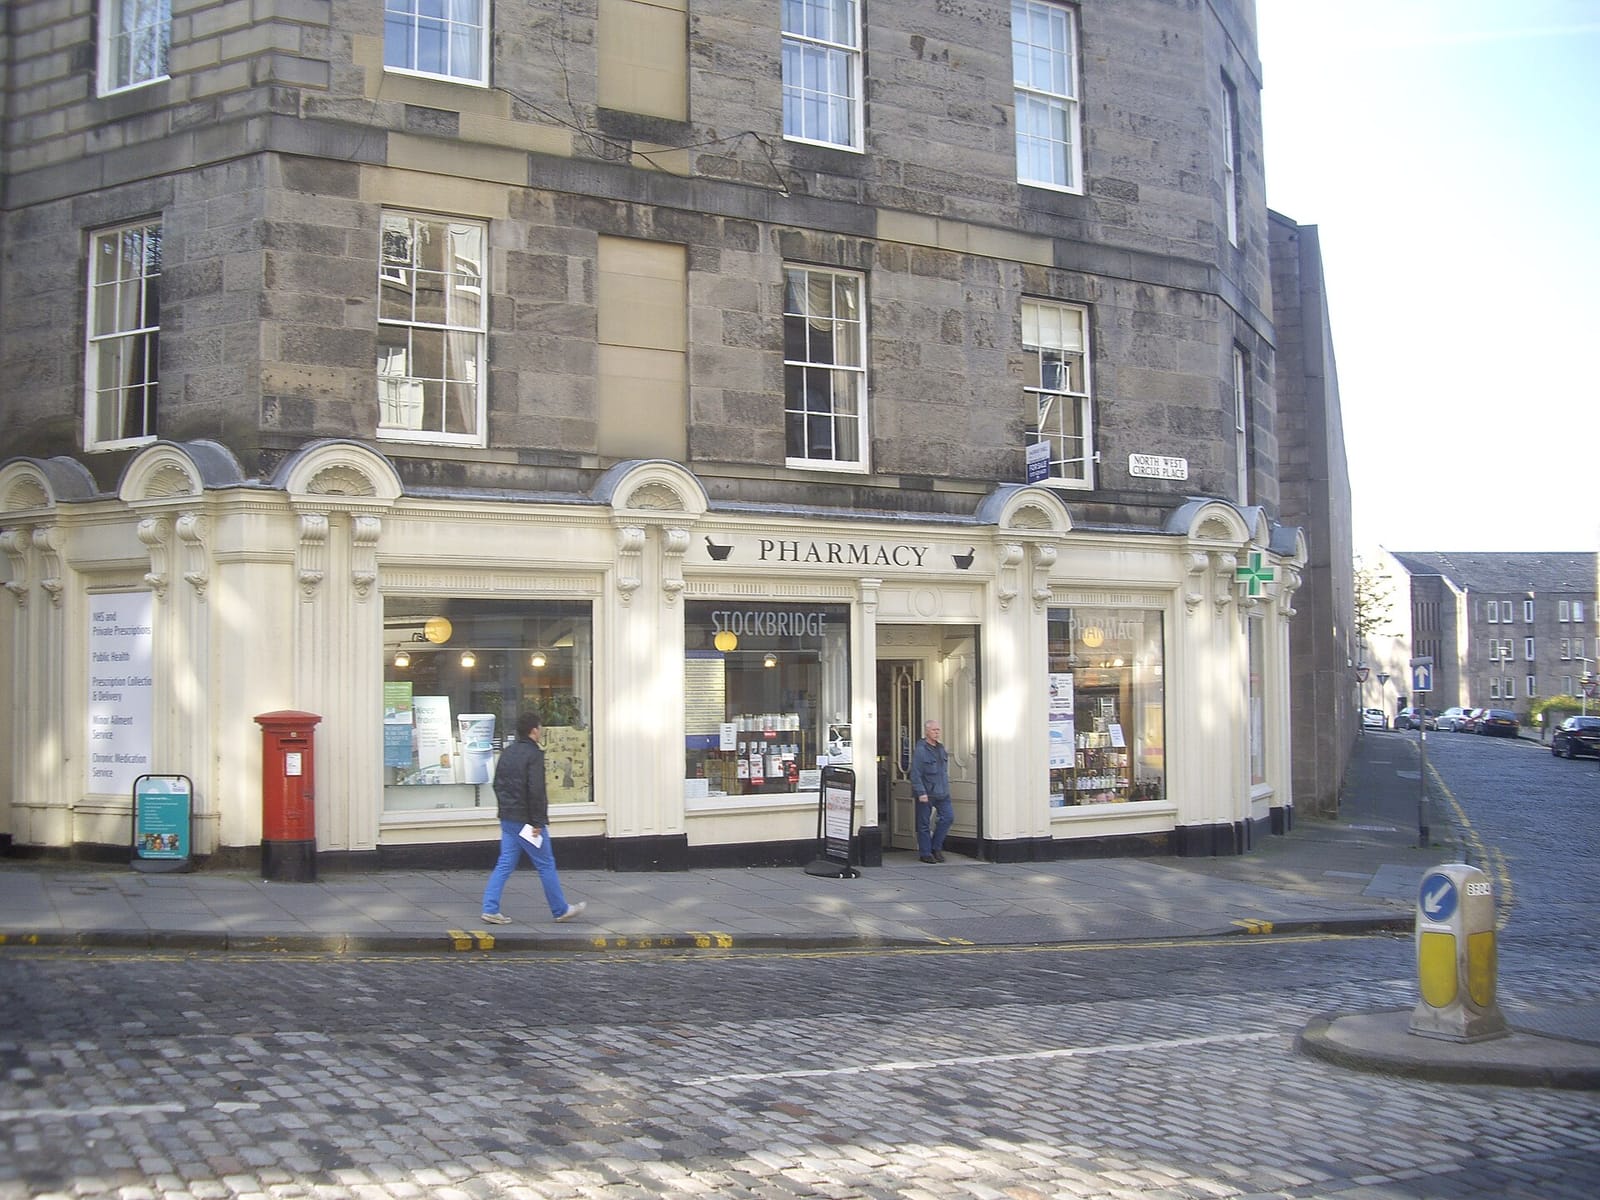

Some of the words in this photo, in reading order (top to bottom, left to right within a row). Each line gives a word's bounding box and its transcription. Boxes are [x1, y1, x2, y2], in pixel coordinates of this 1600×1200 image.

[1133, 455, 1159, 466] NORTH
[1162, 458, 1183, 469] WEST
[1133, 465, 1160, 476] CIRCUS
[1162, 467, 1185, 479] PLACE
[758, 539, 928, 567] PHARMACY
[105, 611, 116, 622] and
[711, 611, 826, 637] STOCKBRIDGE
[1070, 616, 1139, 640] PHARMAC
[92, 626, 113, 637] Private
[114, 625, 152, 637] Prescriptions
[92, 651, 110, 662] Public
[111, 651, 130, 662] Health
[92, 676, 126, 688] Prescription
[127, 675, 152, 687] Collectio
[98, 690, 122, 703] Delivery
[111, 714, 133, 725] Ailment
[92, 729, 113, 740] Service
[92, 752, 113, 763] Chronic
[114, 752, 147, 764] Medication
[92, 766, 113, 777] Service
